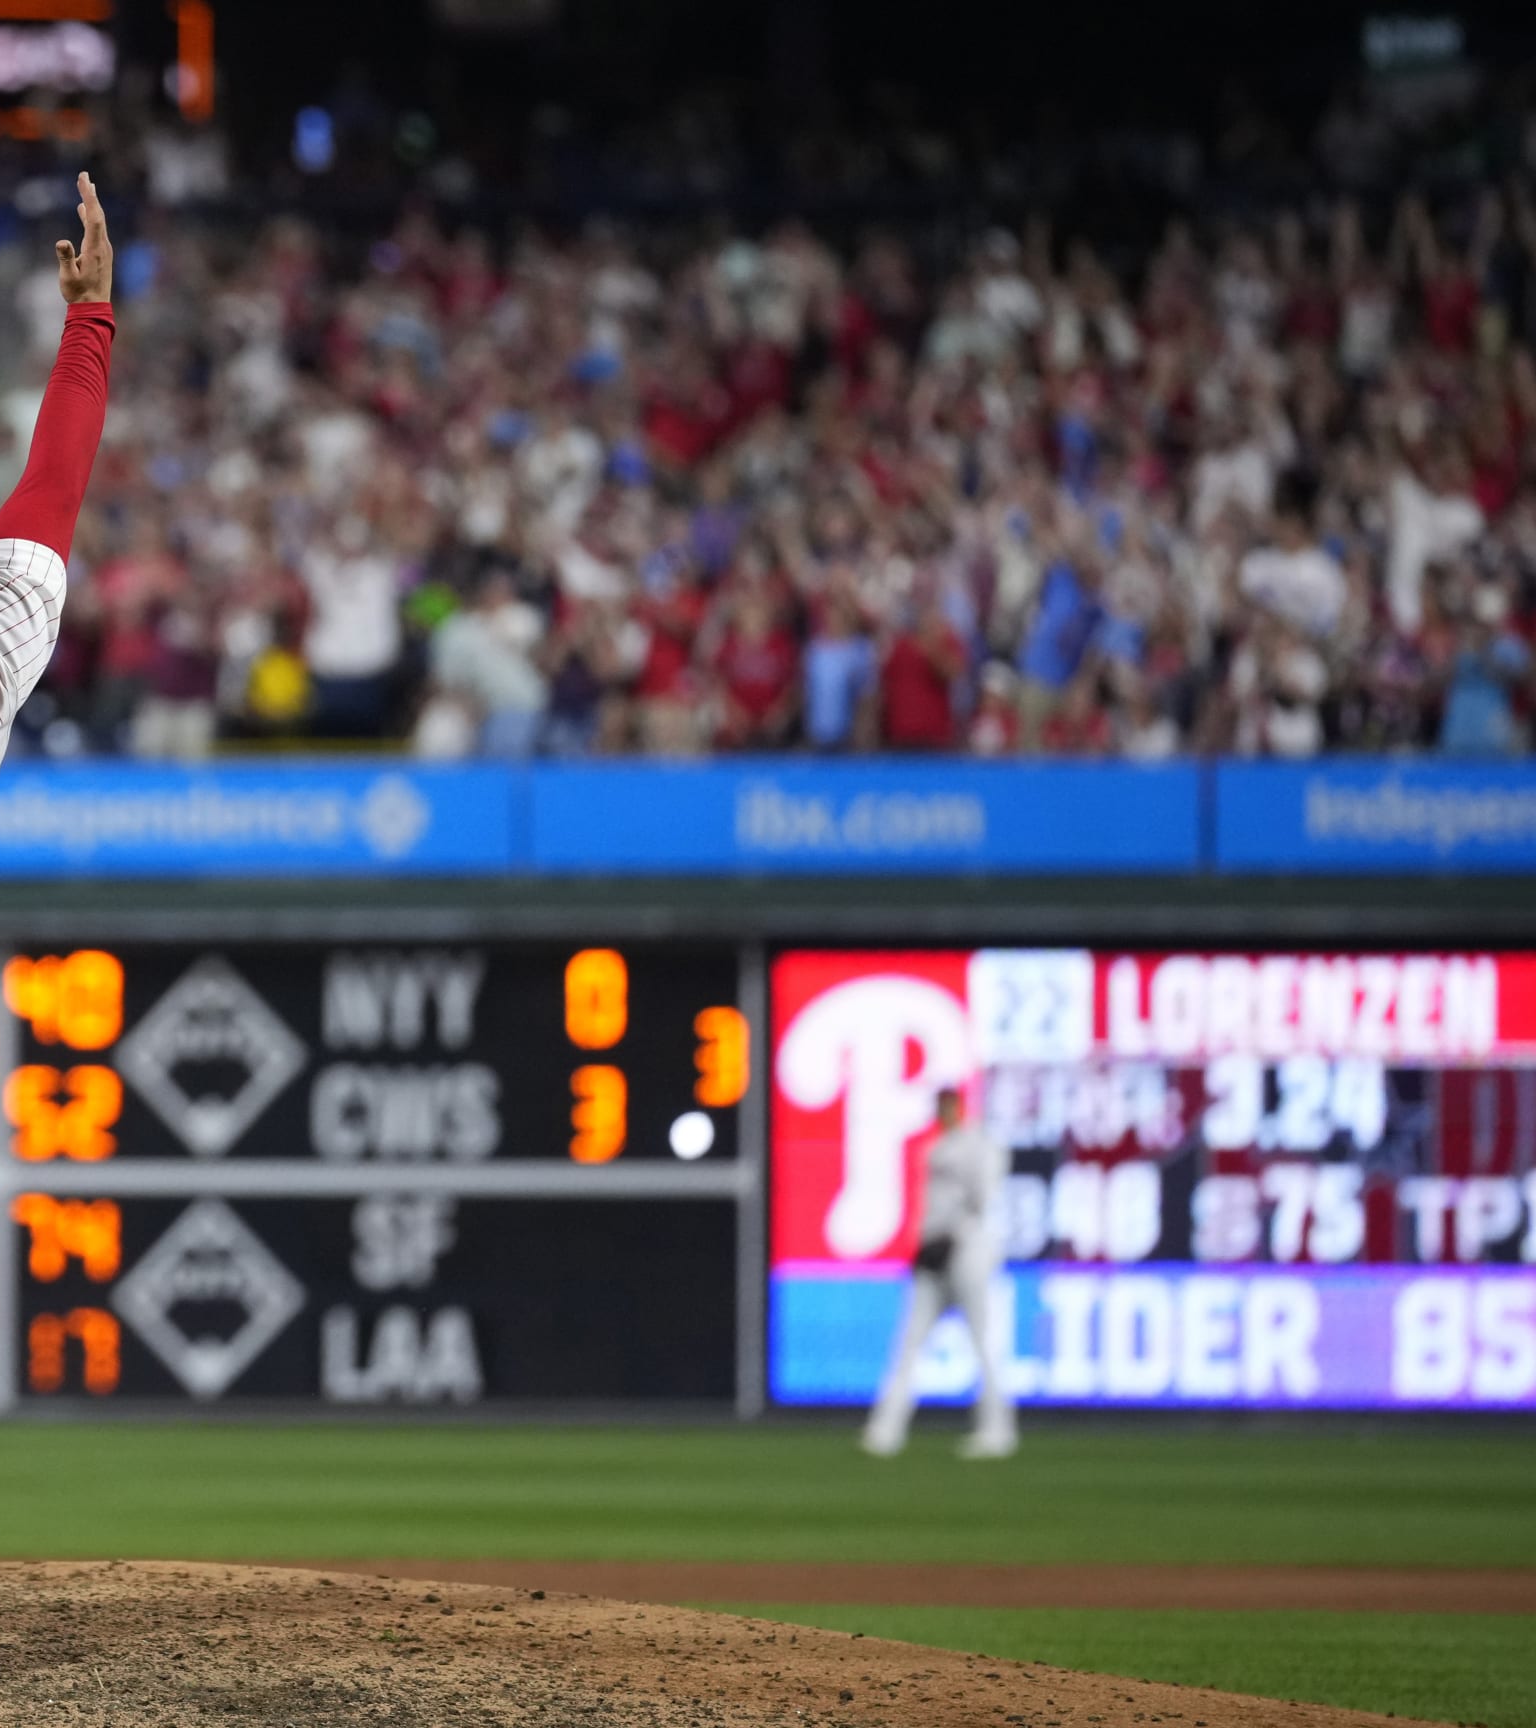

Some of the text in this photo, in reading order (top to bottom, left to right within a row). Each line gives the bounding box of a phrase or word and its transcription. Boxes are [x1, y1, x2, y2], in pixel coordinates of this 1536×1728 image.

[324, 955, 482, 1048] NYY
[565, 948, 628, 1049] 0
[1108, 956, 1497, 1052] LORENZEN
[694, 1006, 750, 1107] 3
[1204, 1056, 1386, 1150] 3.24
[569, 1064, 627, 1163] 3
[322, 1305, 483, 1397] LAA
[1393, 1278, 1536, 1400] 85
